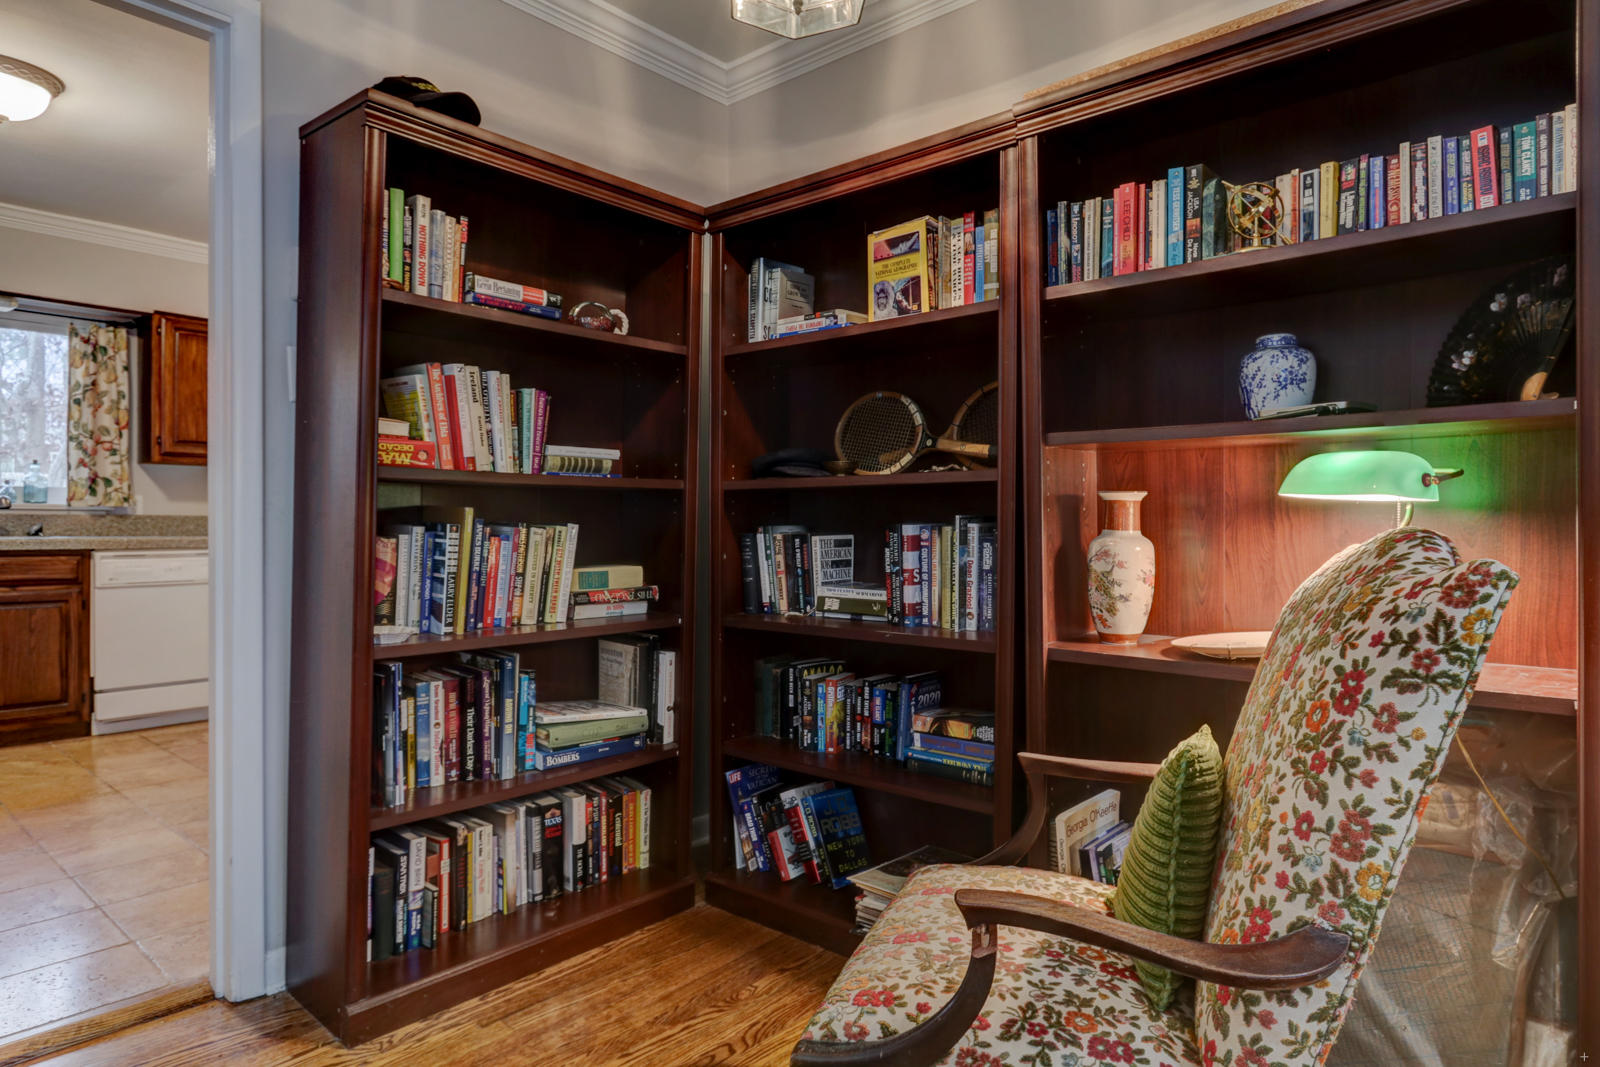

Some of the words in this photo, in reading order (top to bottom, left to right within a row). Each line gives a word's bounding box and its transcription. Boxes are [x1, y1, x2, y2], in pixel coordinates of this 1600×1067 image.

[1521, 151, 1531, 176] CLANCY
[1123, 216, 1131, 241] CHILD
[418, 224, 427, 260] NOTHING
[418, 261, 426, 287] DOWN
[469, 371, 479, 403] Ireland
[377, 451, 413, 465] MA
[475, 523, 483, 545] JAMES
[820, 540, 834, 549] THE
[473, 547, 481, 572] BURKE
[820, 549, 852, 559] AMERICAN
[820, 559, 831, 569] JOB
[447, 574, 455, 597] LARRY
[822, 569, 851, 581] MACHINE
[921, 573, 928, 581] OF
[446, 599, 454, 623] ELDER
[918, 690, 941, 706] 2020
[466, 707, 475, 728] Their
[466, 728, 474, 755] Darkest
[465, 755, 474, 770] Day
[546, 753, 580, 767] BOMBERS
[729, 771, 742, 784] LIFE
[544, 815, 562, 827] TEXAS
[821, 811, 862, 833] ROBB
[1065, 817, 1089, 838] Georgia
[414, 841, 422, 866] DAVID
[827, 841, 844, 852] NEW
[838, 857, 868, 874] DALLAS
